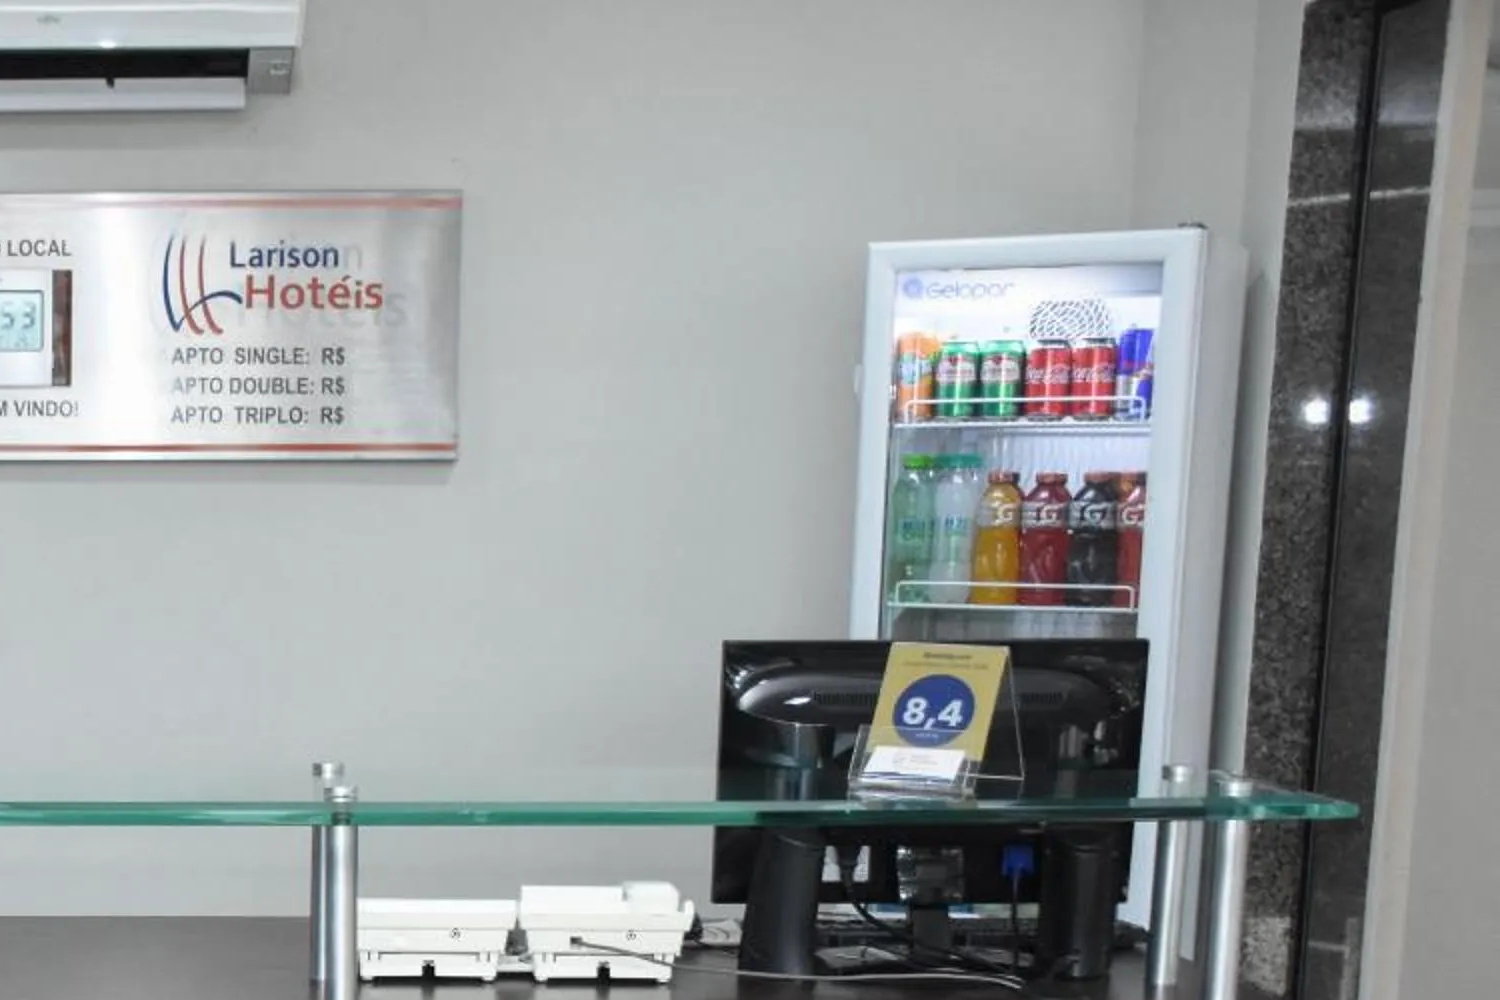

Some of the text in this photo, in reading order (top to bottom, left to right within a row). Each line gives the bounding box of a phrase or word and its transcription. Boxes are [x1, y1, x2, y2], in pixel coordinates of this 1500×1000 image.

[7, 239, 72, 257] LOCAL
[230, 240, 339, 268] Larison
[245, 275, 383, 309] Hotéis
[171, 346, 346, 366] APTO SINGLE: R$
[171, 377, 346, 396] APTO DOUBLE: R$
[14, 400, 79, 417] VINDO!
[171, 406, 346, 425] APTO TRIPLO: R$
[902, 696, 963, 731] 8,4
